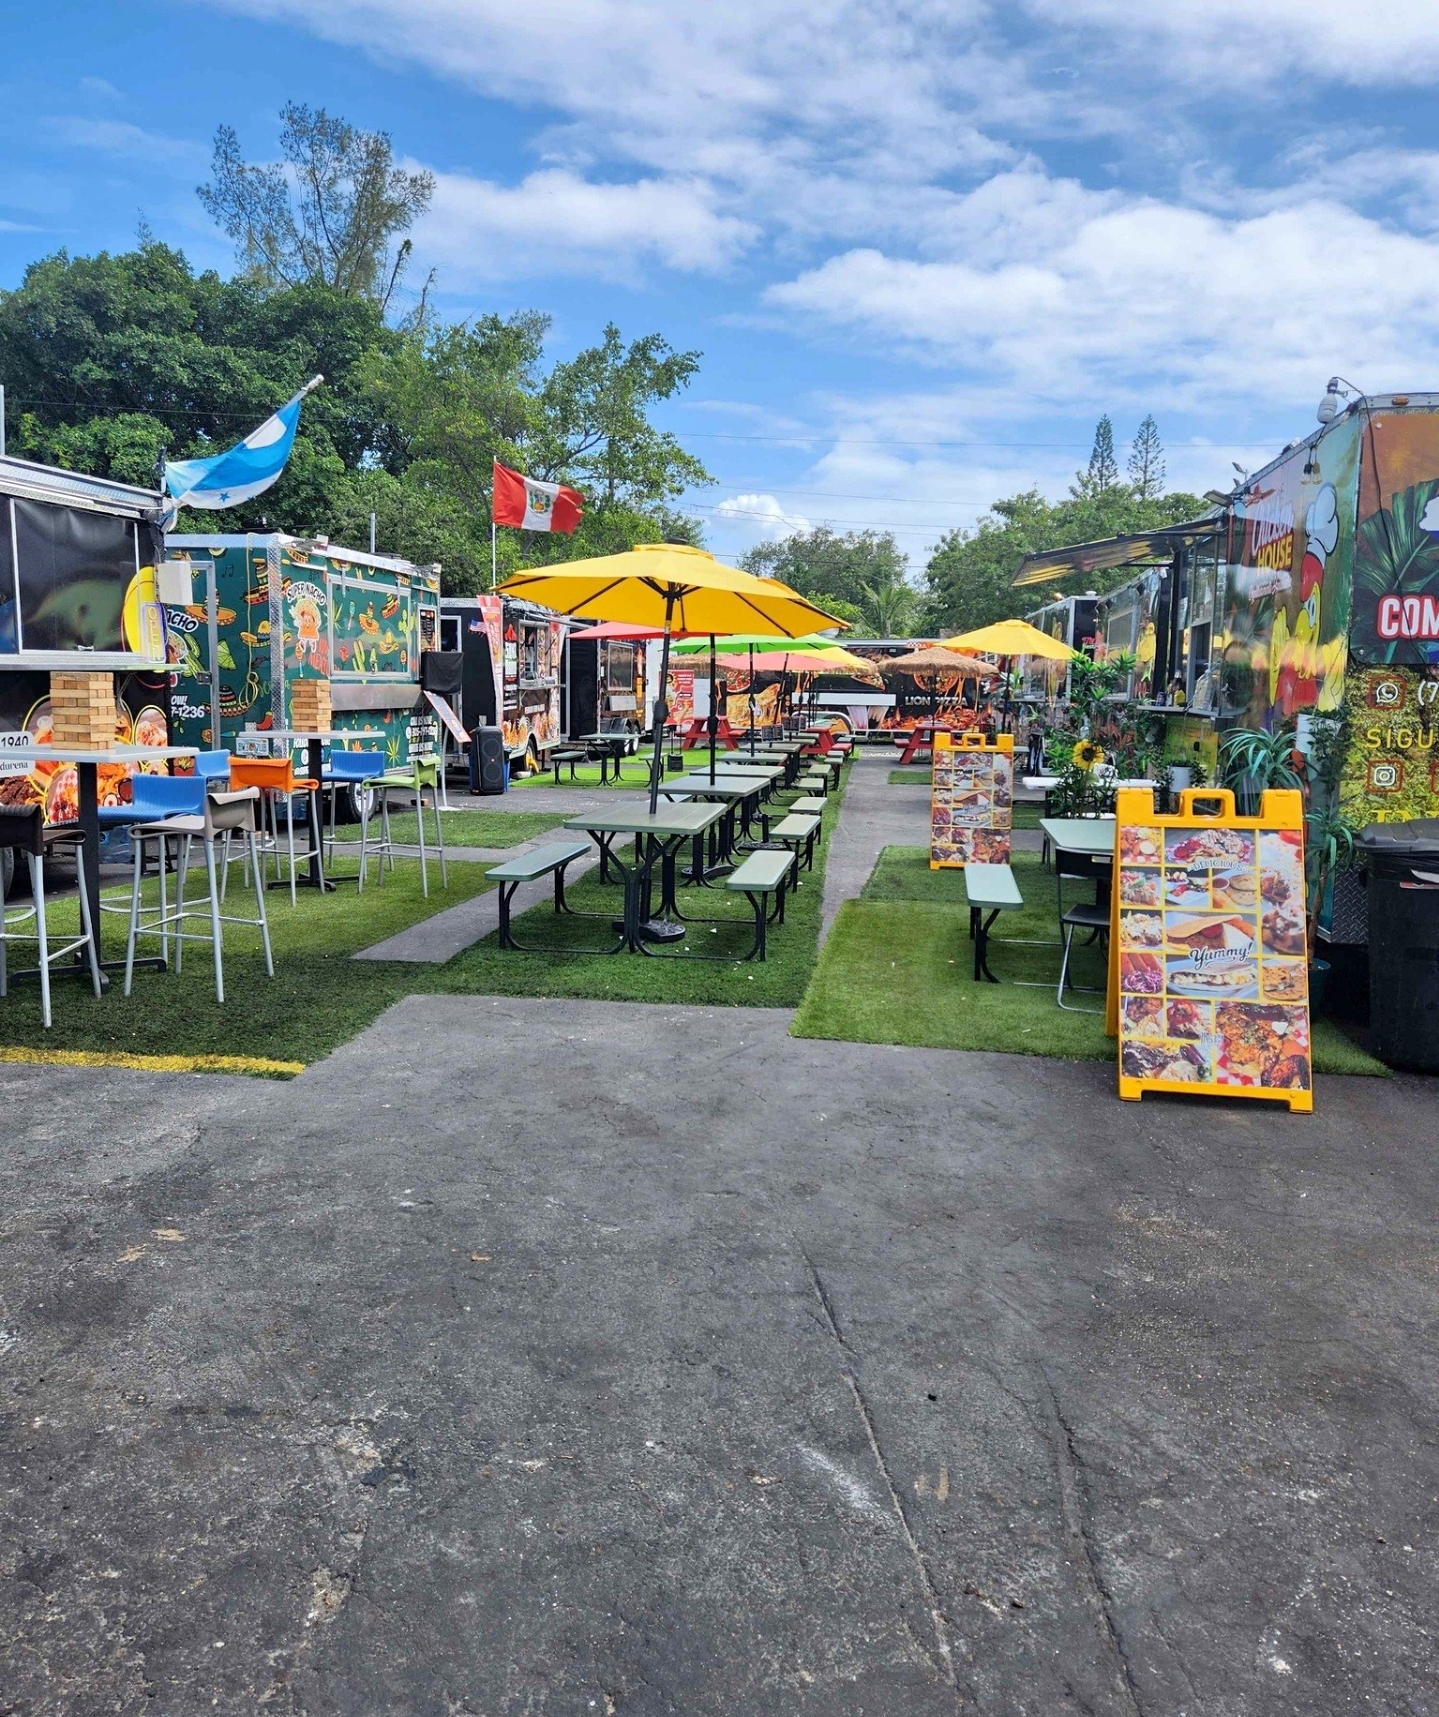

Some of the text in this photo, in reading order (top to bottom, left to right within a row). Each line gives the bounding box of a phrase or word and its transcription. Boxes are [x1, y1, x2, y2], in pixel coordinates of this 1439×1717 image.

[1257, 534, 1293, 577] HOUSE
[287, 582, 326, 605] SUPER NACHO
[905, 696, 968, 706] LION PIZZA
[1193, 860, 1245, 872] DELICIOUS
[1189, 942, 1253, 971] Yummy!
